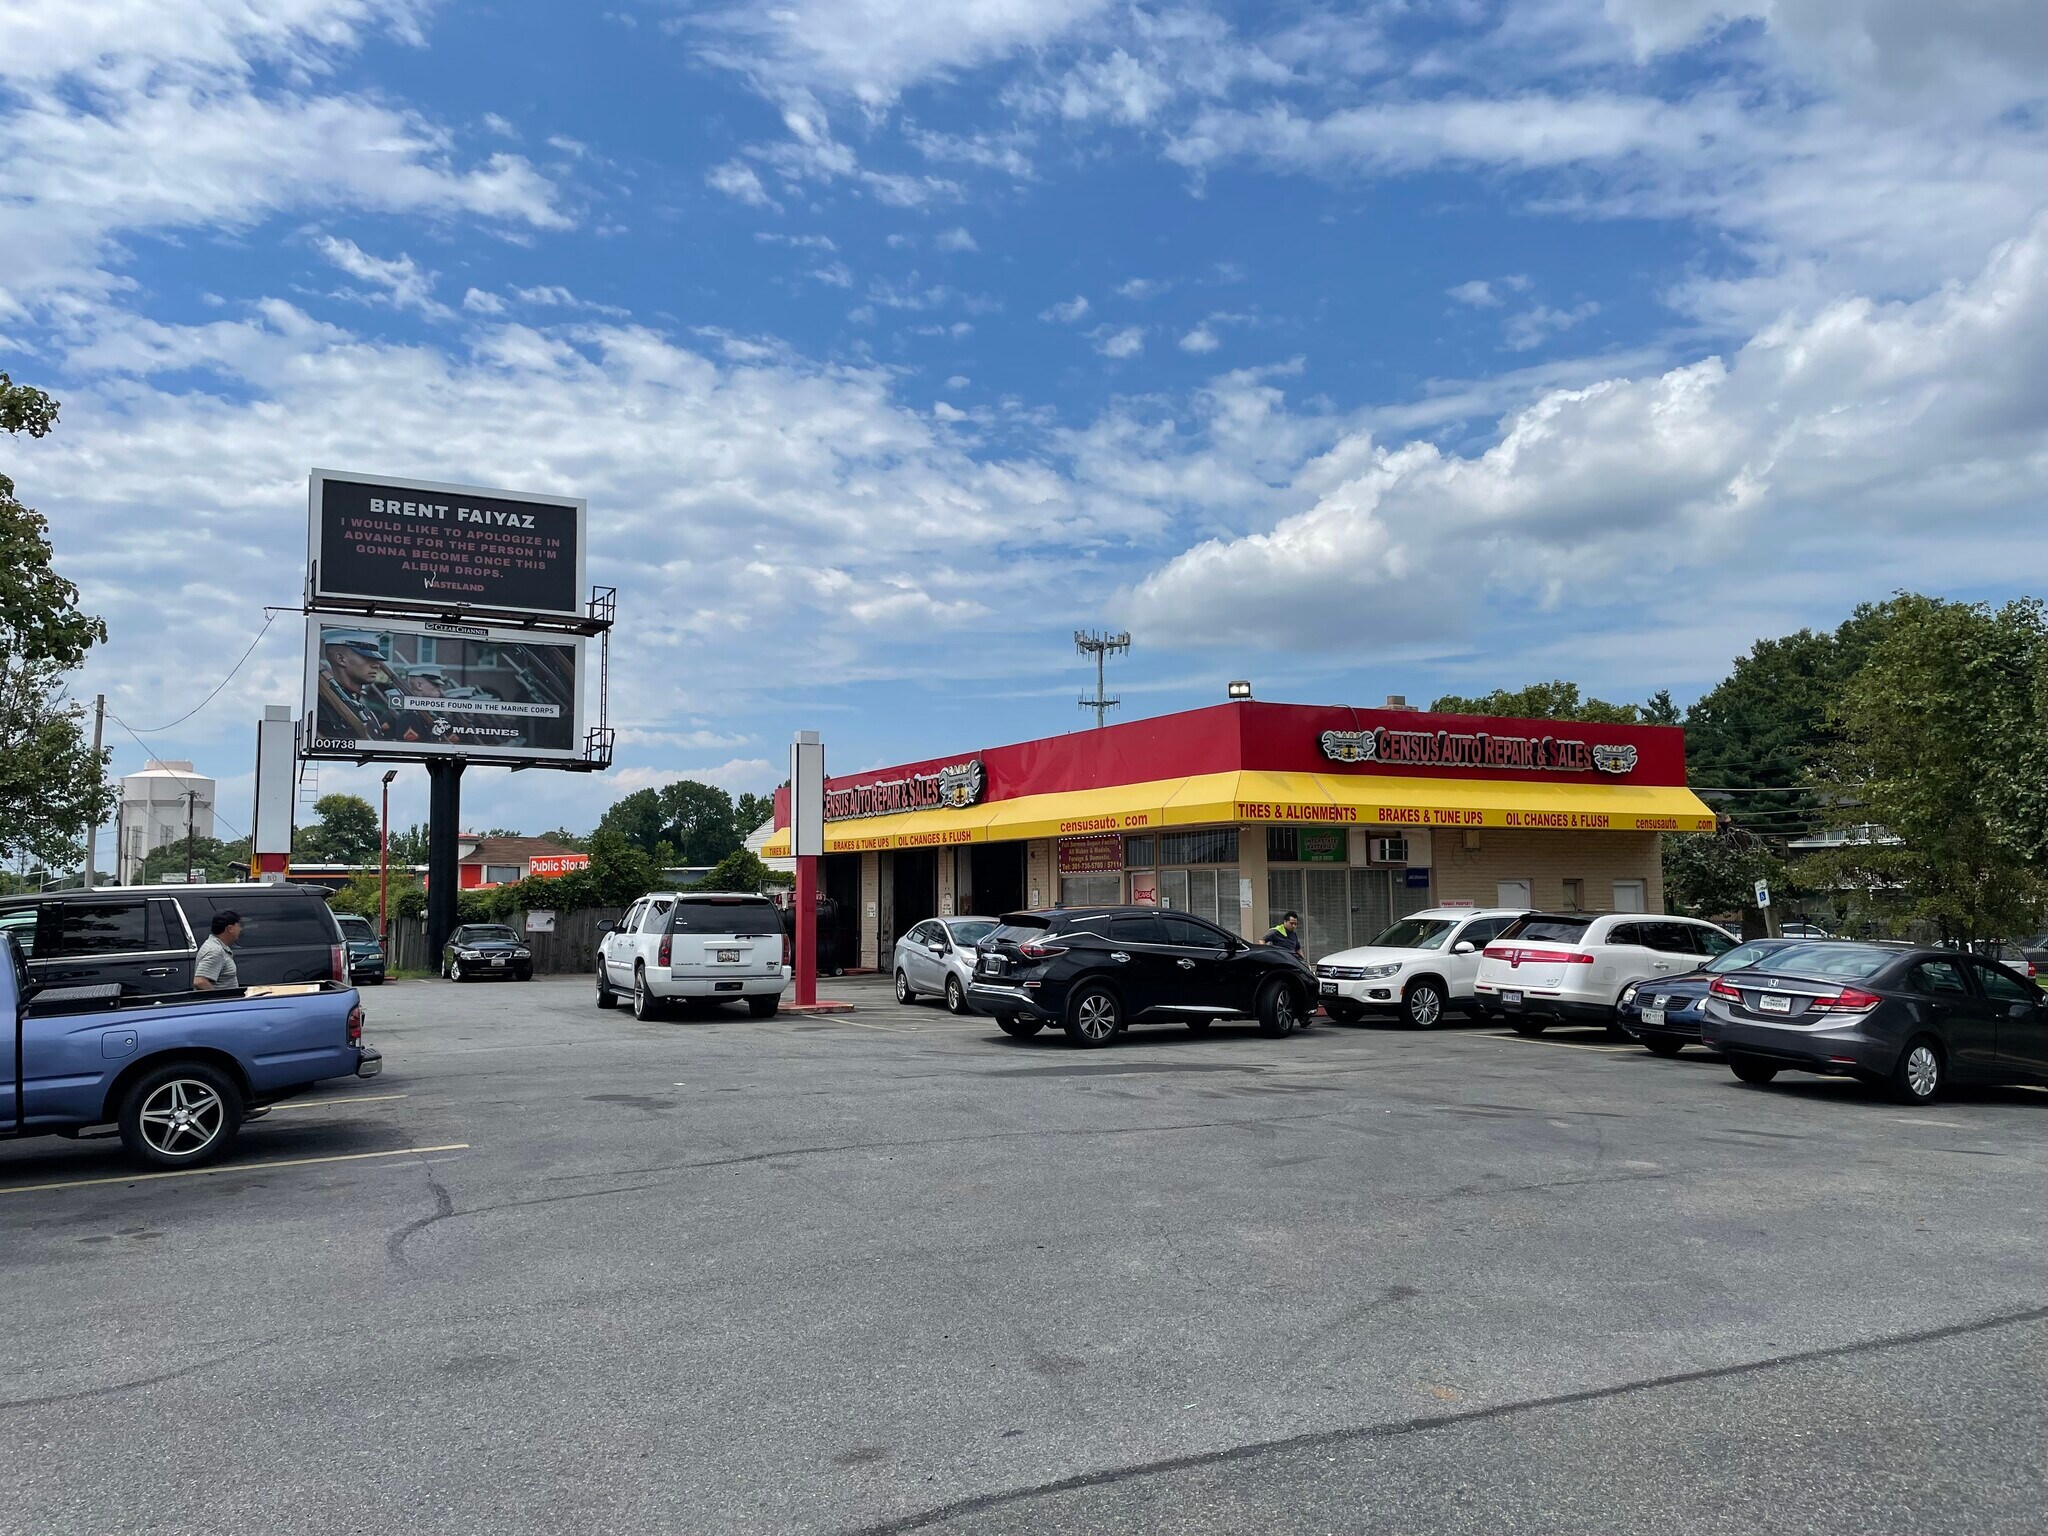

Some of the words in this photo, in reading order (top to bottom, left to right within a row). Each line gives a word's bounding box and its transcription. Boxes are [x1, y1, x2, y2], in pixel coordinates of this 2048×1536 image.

[370, 498, 449, 520] BRENT
[458, 508, 535, 529] FAIYAZ
[340, 517, 345, 526] I
[351, 518, 402, 531] WOULD
[407, 524, 439, 535] LIKE
[444, 527, 461, 537] TO
[466, 530, 542, 546] APOLOGIZE
[547, 538, 560, 548] IN
[344, 530, 411, 545] ADVANCE
[417, 538, 444, 548] FOR
[449, 541, 475, 552] THE
[481, 544, 534, 557] PERSON
[538, 549, 557, 559] I'M
[356, 544, 407, 557] GONNA
[412, 550, 469, 563] BECOME
[474, 555, 511, 567] ONCE
[516, 559, 546, 570] THIS
[401, 561, 450, 574] ALBUM
[455, 565, 504, 578] DROPS.
[424, 572, 485, 592] WASTELAND
[410, 700, 445, 708] PURPOSE
[447, 702, 473, 710] FOUND
[501, 705, 528, 713] MARINE
[530, 706, 554, 714] CORPS
[452, 726, 520, 737] MARINES
[316, 739, 355, 749] 001738
[1380, 730, 1439, 762] CENSUS
[1441, 735, 1481, 763] AUTO
[1485, 736, 1533, 766] REPAIR
[1537, 741, 1547, 766] &
[1549, 740, 1592, 768] SALES
[849, 789, 871, 815] AUTO
[872, 784, 900, 812] REPAIR
[902, 784, 908, 808] &
[909, 778, 938, 807] SALES
[1238, 803, 1271, 818] TIRES
[1275, 804, 1282, 818] &
[1286, 805, 1357, 821] ALIGNMENTS
[1378, 808, 1420, 823] BRAKES
[1423, 809, 1431, 823] &
[1434, 810, 1461, 824] TUNE
[1464, 811, 1483, 825] UPS
[1506, 812, 1522, 826] OIL
[1524, 813, 1568, 827] CHANGES
[1571, 814, 1578, 827] &
[1581, 814, 1609, 828] FLUSH
[1060, 816, 1120, 832] censusauto.
[1125, 814, 1148, 827] com
[1636, 818, 1679, 829] censusauto.
[1696, 819, 1713, 830] .com
[834, 840, 855, 850] BRAKES
[861, 840, 877, 849] TUNE
[878, 839, 889, 848] UPS
[898, 836, 908, 846] OIL
[910, 834, 941, 845] CHANGES
[942, 833, 947, 843] &
[949, 831, 971, 842] FLUSH
[769, 848, 781, 856] TIRES
[531, 860, 559, 872] Public
